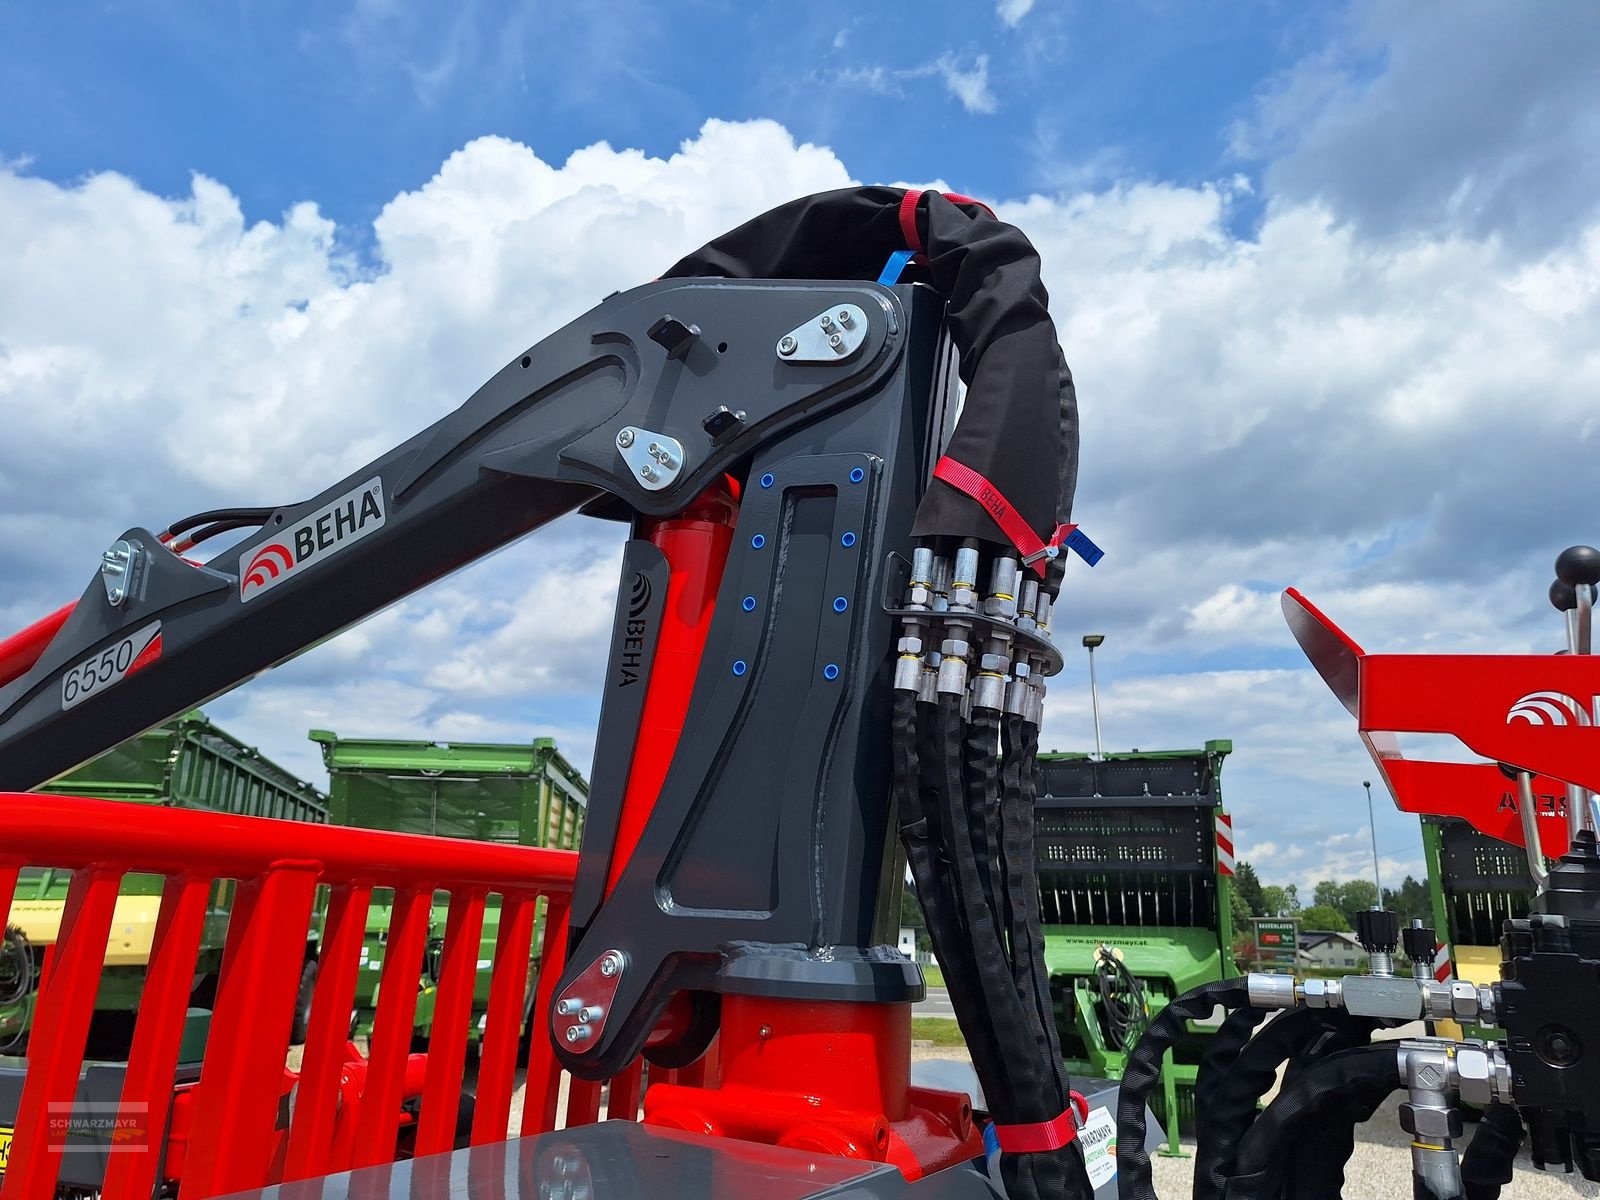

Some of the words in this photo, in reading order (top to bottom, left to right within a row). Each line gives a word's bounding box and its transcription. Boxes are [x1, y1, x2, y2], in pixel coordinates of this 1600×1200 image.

[294, 490, 382, 564] BEHA
[980, 487, 1008, 519] BEHA
[64, 639, 133, 702] 6550
[619, 619, 646, 688] BEHA
[1065, 938, 1148, 946] www.schwarzmayr.at
